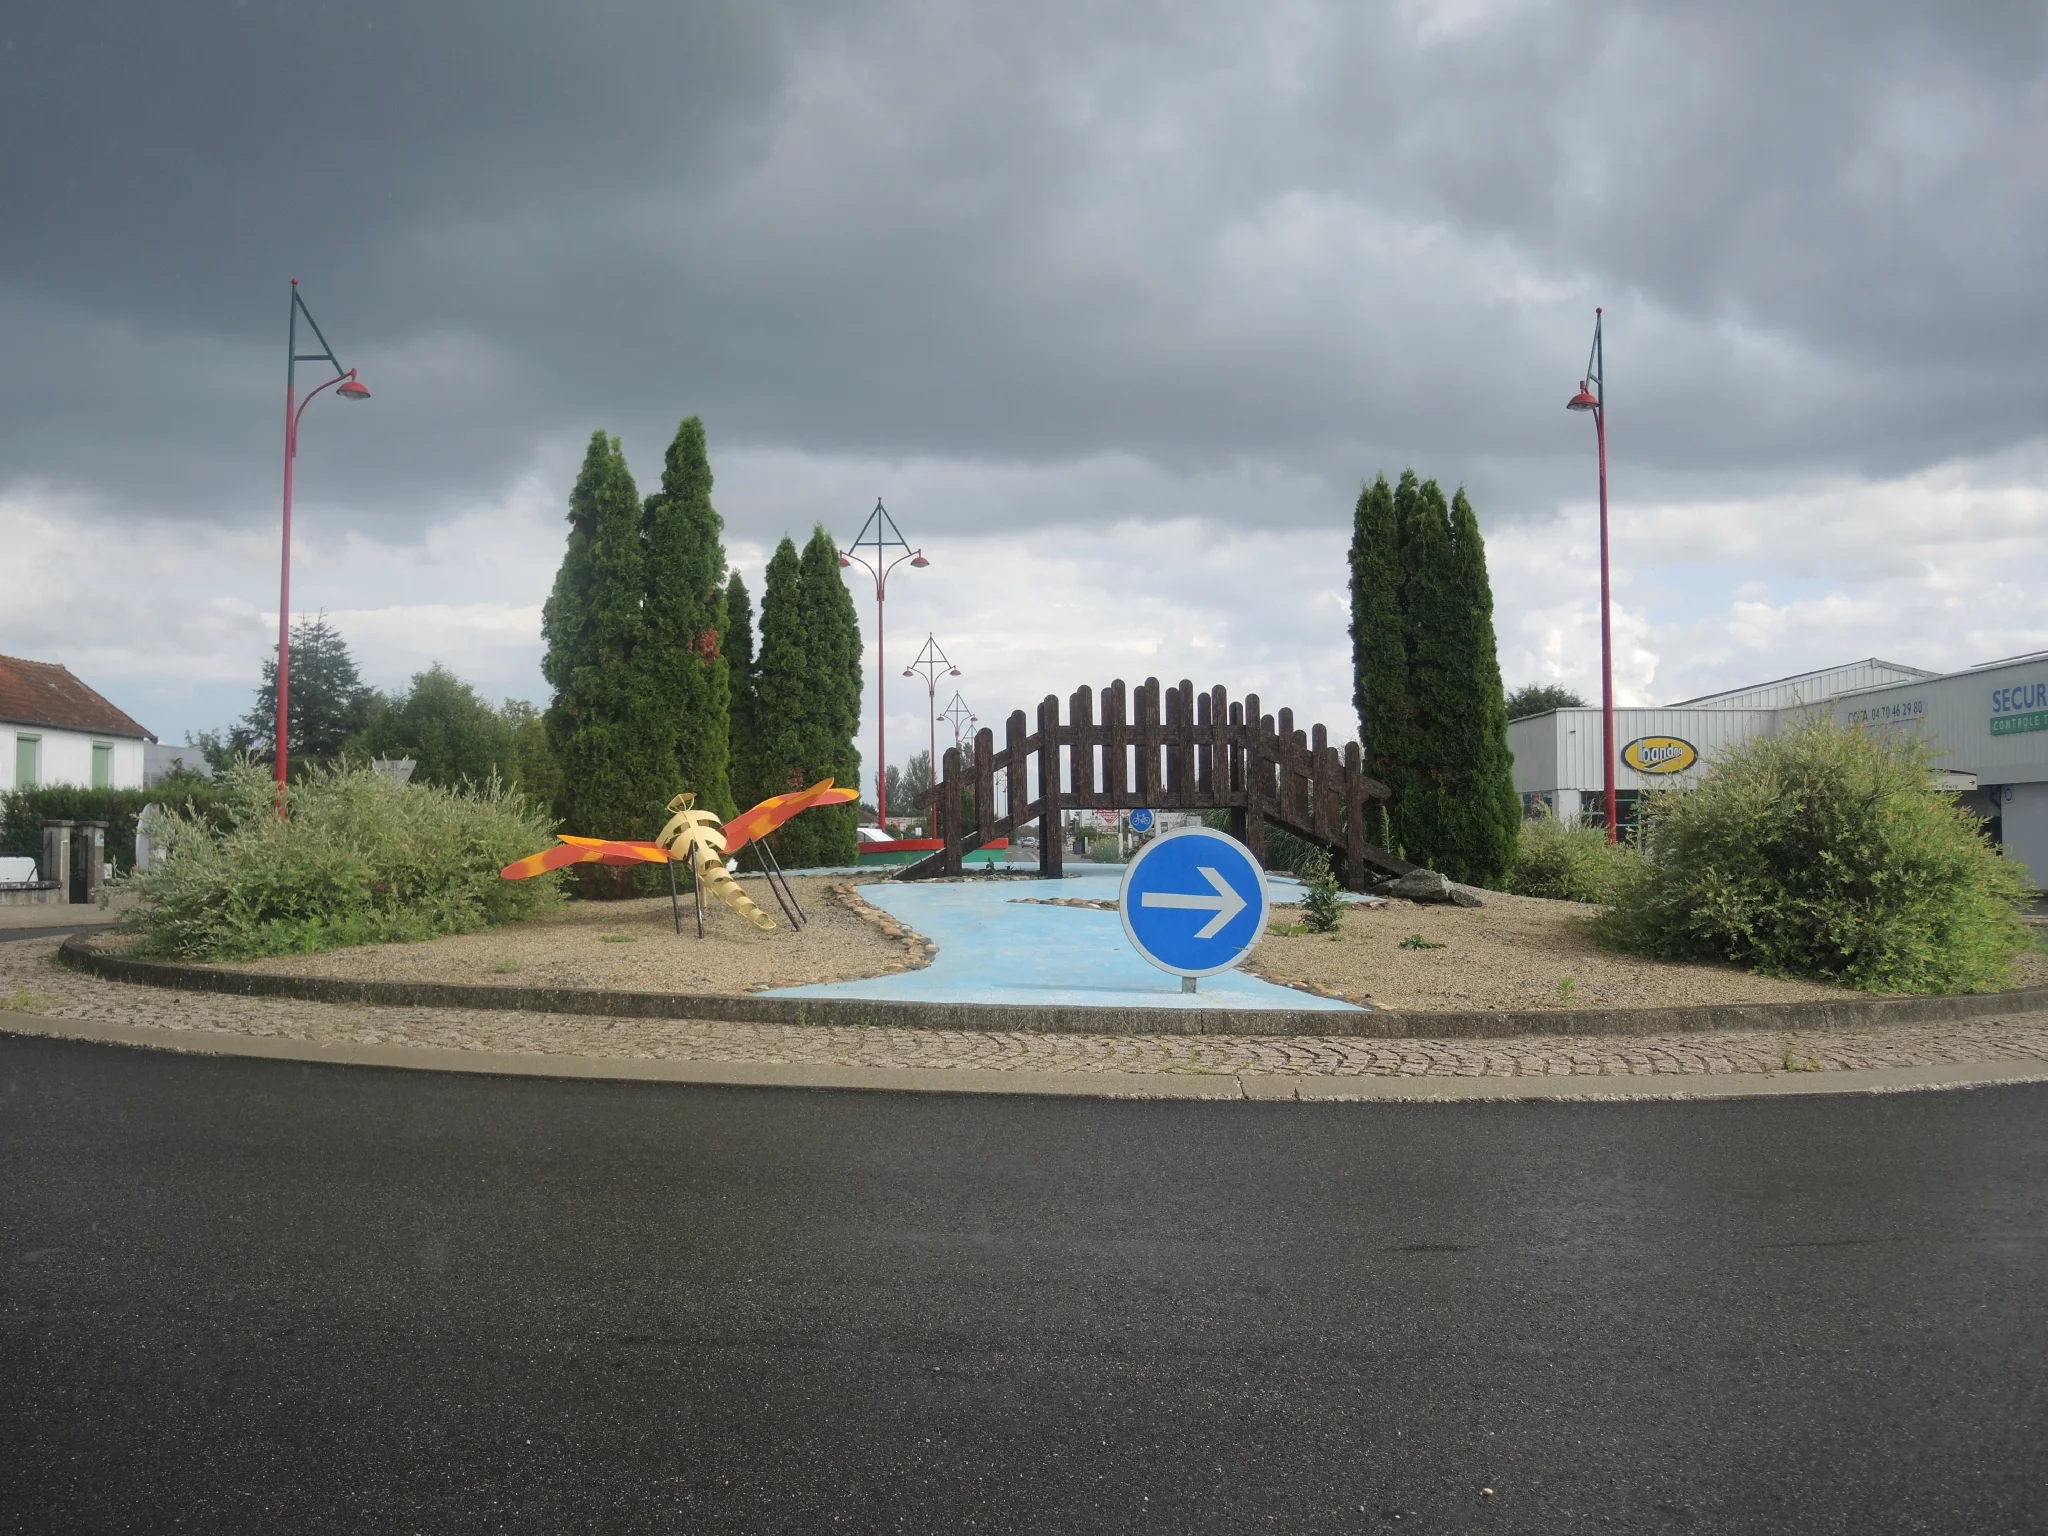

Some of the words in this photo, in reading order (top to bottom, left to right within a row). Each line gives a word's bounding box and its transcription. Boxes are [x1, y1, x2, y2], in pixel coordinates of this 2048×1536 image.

[1992, 683, 2048, 713] SECUR
[1871, 708, 1880, 720] 04
[1882, 706, 1890, 718] 70
[1892, 703, 1900, 717] 46
[1902, 702, 1911, 716] 29
[1913, 700, 1923, 715] 80
[1993, 715, 2040, 731] CONTROLE
